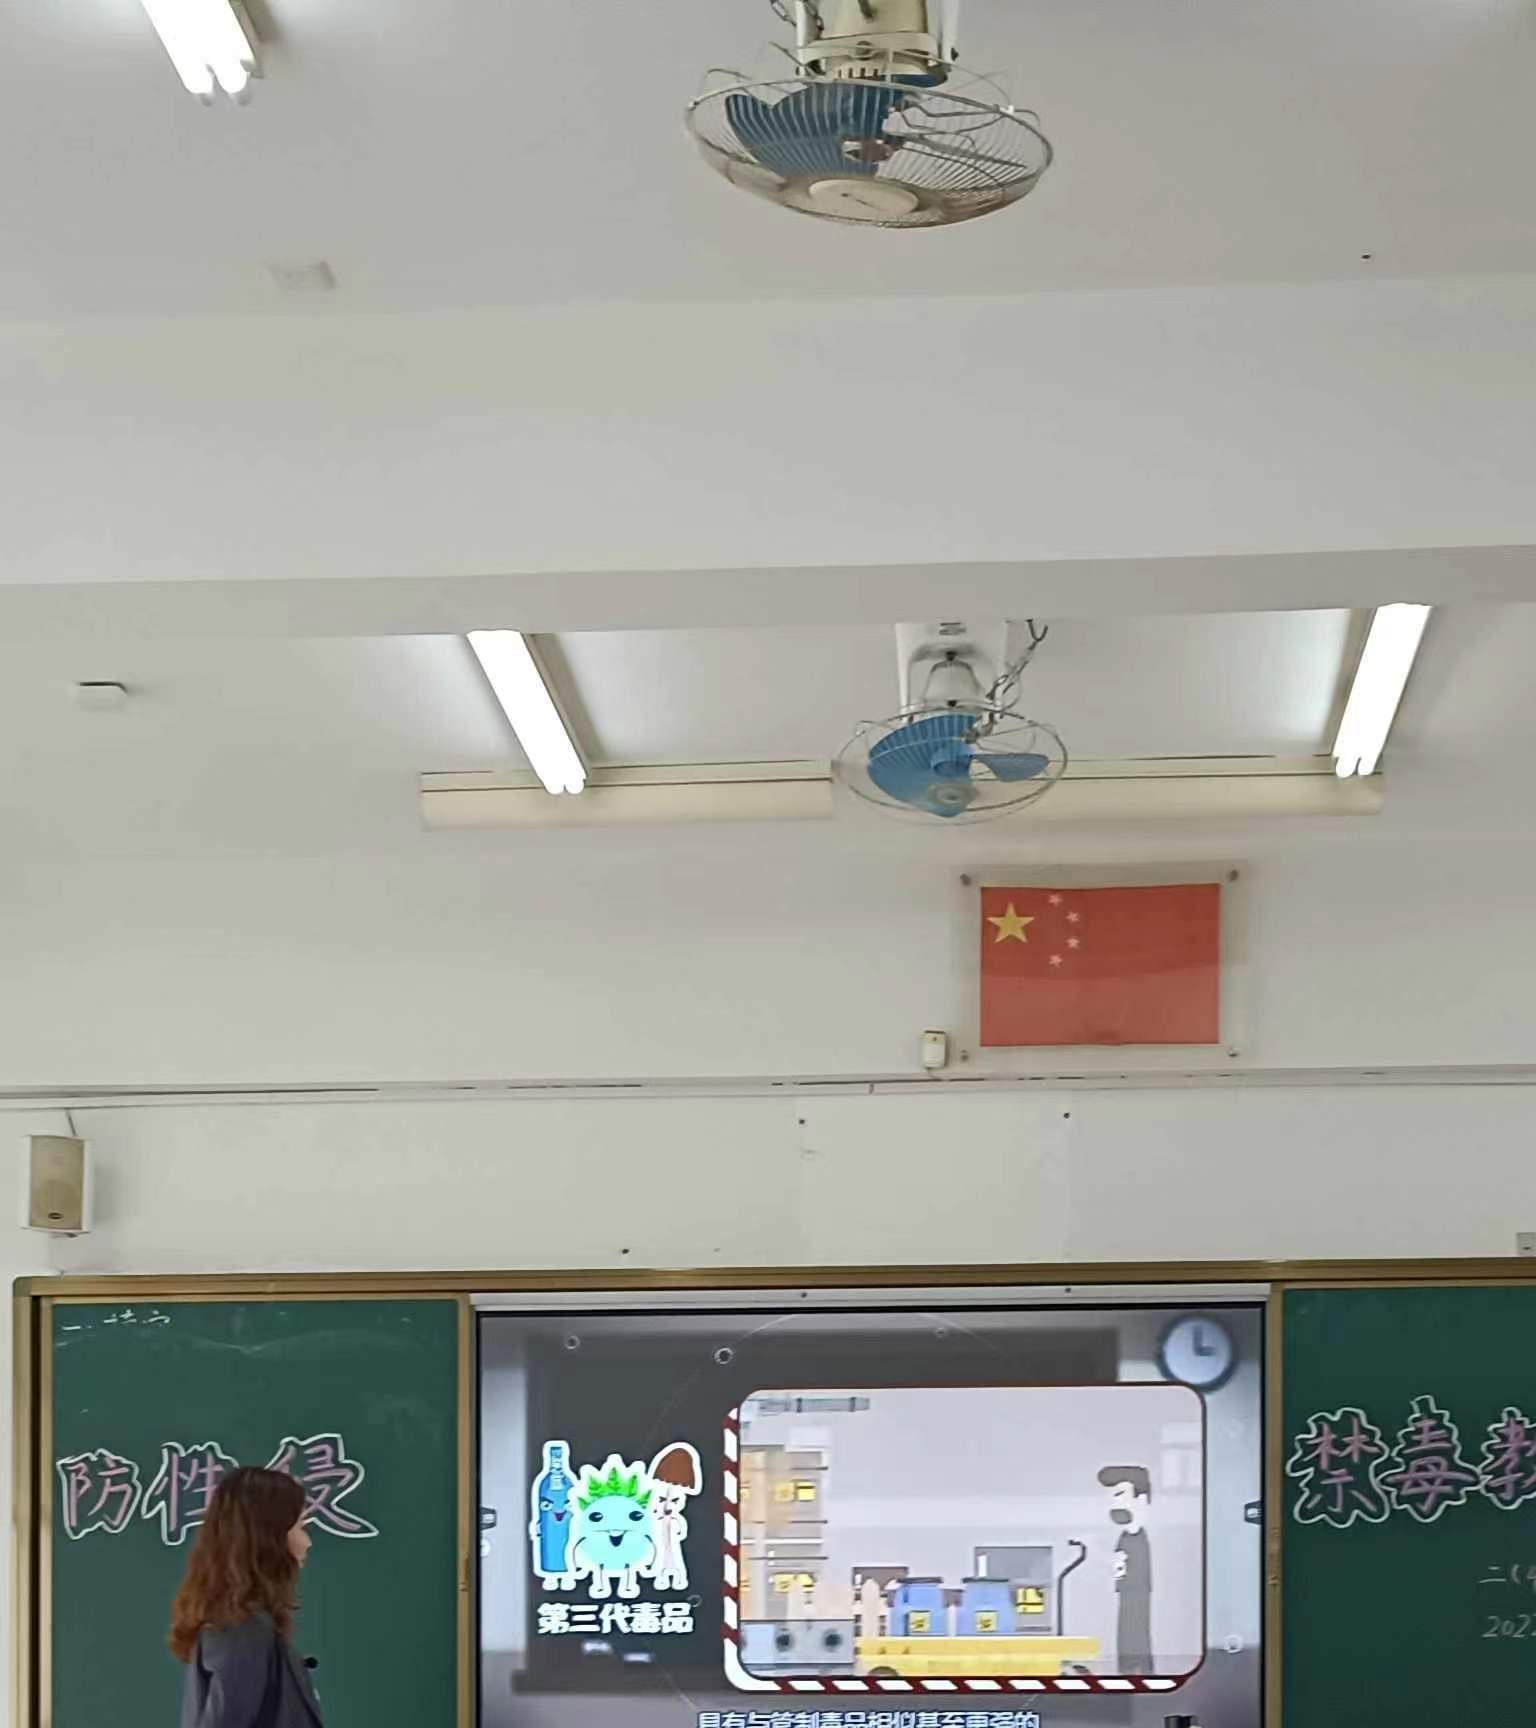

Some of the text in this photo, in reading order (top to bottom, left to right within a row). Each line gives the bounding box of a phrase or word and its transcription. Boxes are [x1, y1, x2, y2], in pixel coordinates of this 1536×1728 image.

[57, 1432, 380, 1545] 防性侵
[536, 1602, 695, 1635] 第三代毒品
